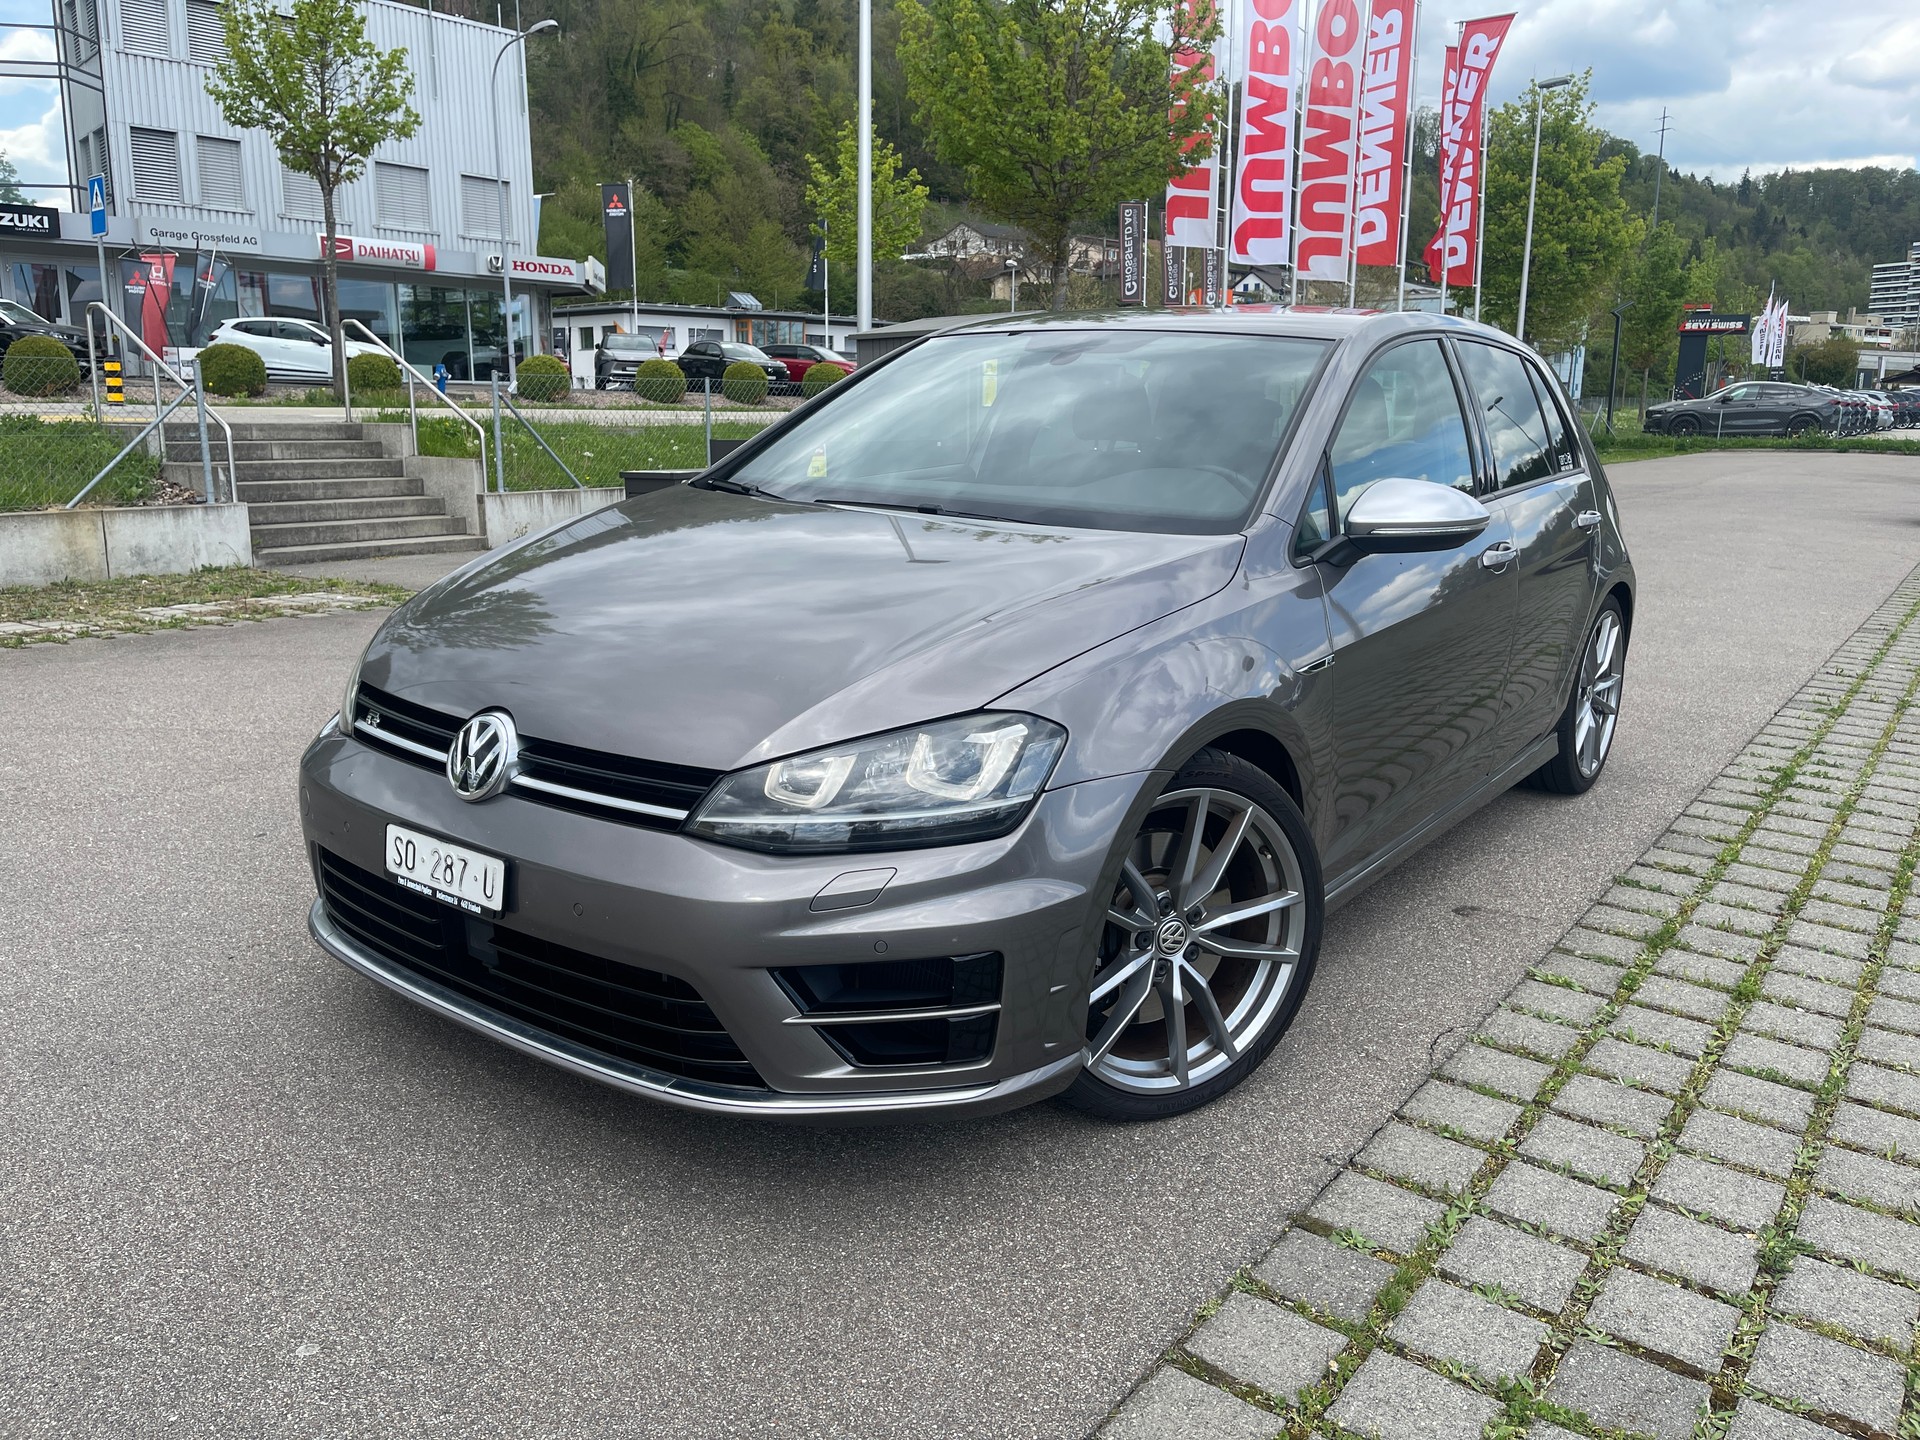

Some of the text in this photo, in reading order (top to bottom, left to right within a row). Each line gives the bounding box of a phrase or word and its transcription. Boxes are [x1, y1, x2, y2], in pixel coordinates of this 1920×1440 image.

[0, 212, 49, 229] ZUKI
[150, 227, 258, 246] Garage Grossfeld AG
[358, 244, 420, 262] DAIHATSU
[512, 260, 575, 276] HONDA
[1685, 321, 1744, 330] SEVI SWISS
[393, 835, 416, 871] SO
[430, 847, 469, 892] 287
[483, 863, 498, 901] U
